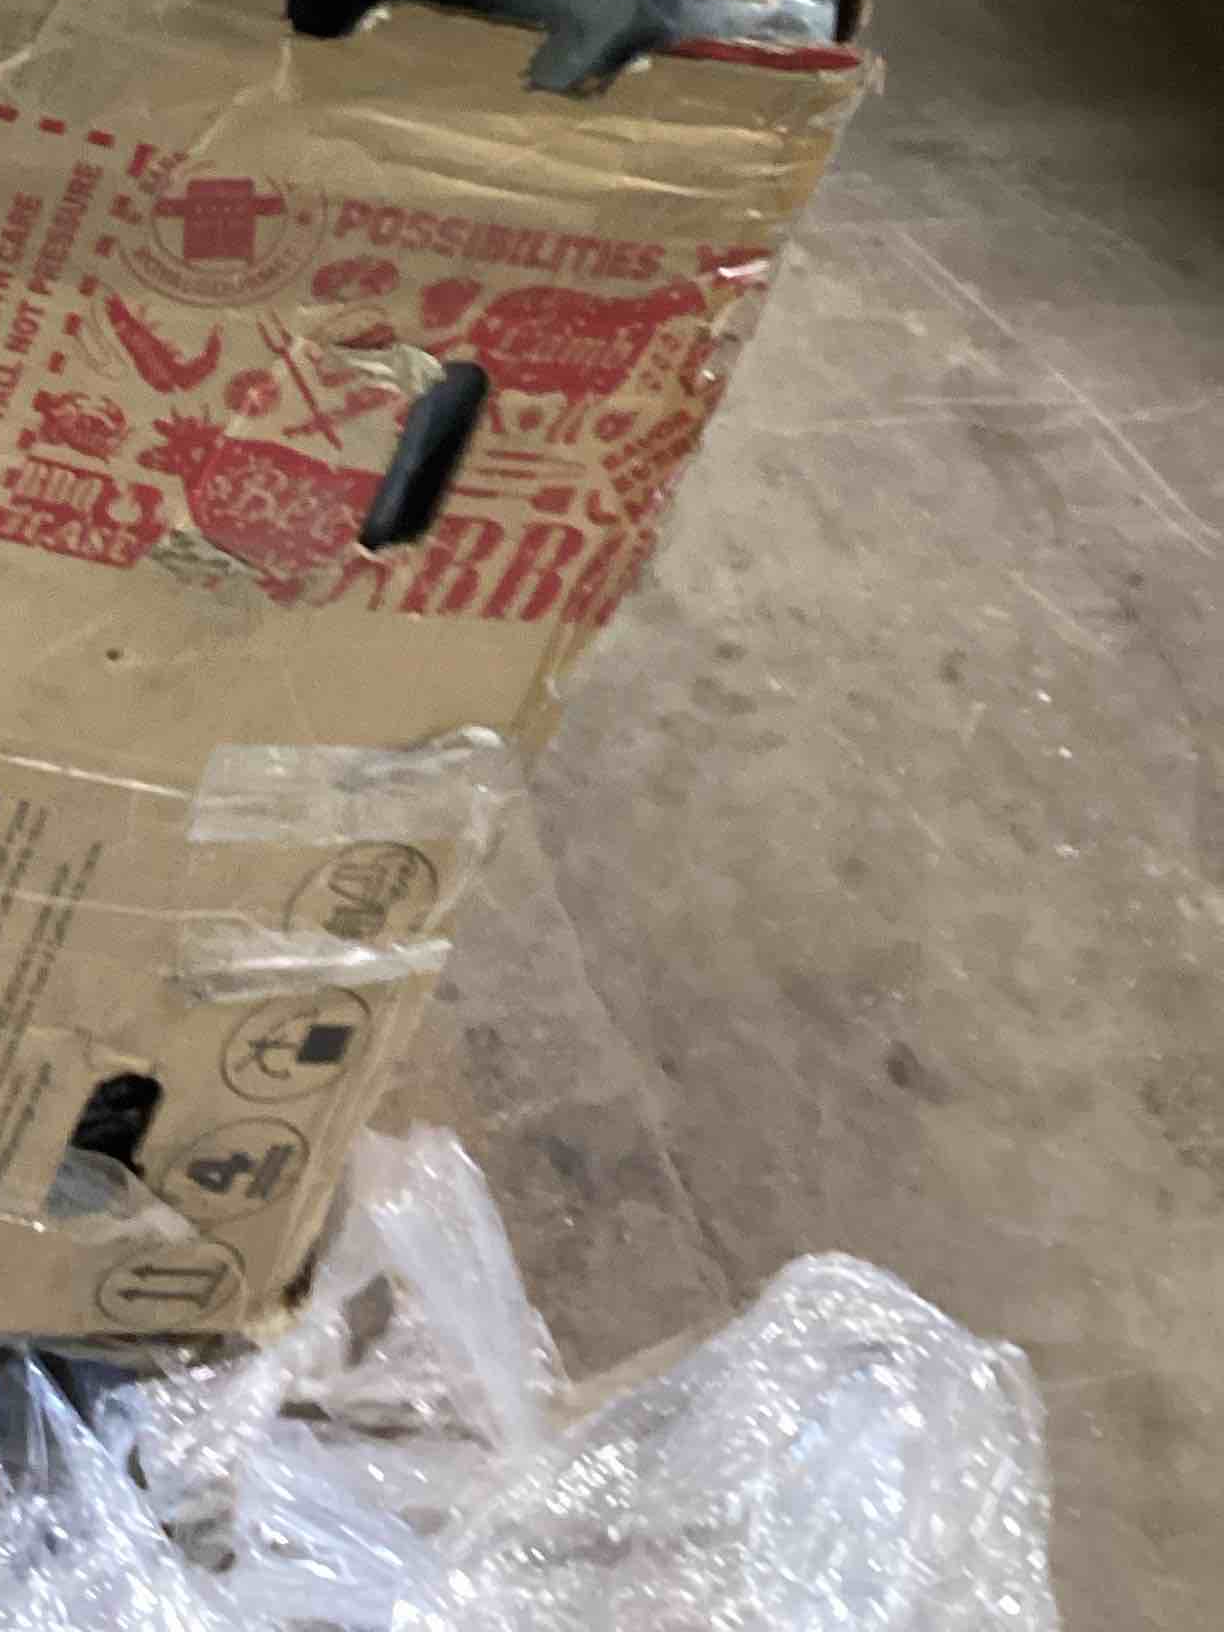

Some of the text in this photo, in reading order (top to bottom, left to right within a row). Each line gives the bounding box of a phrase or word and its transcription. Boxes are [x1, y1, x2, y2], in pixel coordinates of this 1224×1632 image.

[3, 290, 48, 356] NOT
[26, 159, 106, 292] PRESSURE
[332, 199, 665, 282] POSSIBILITIES
